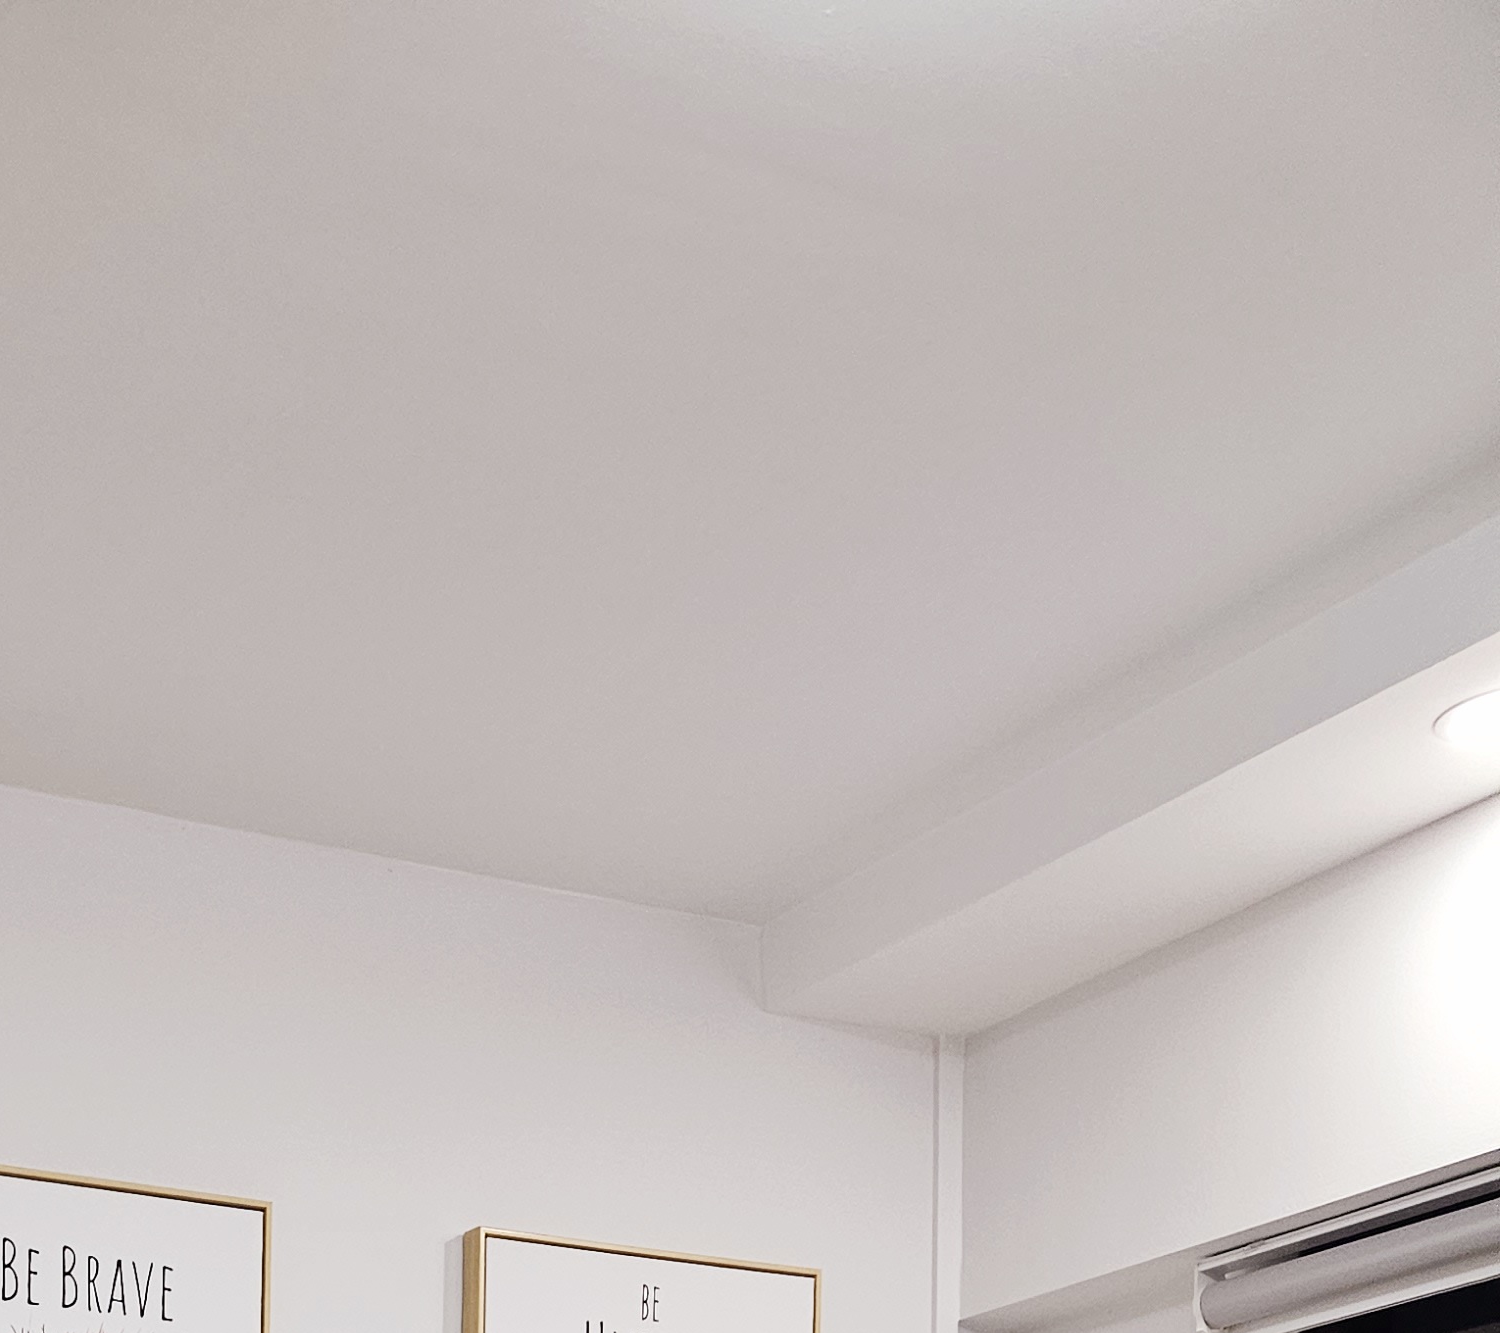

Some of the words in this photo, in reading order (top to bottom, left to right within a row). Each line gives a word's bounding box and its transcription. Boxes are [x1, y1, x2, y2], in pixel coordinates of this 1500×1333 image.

[1, 1237, 40, 1305] BE
[61, 1245, 174, 1321] BRAVE
[641, 1283, 660, 1322] BE
